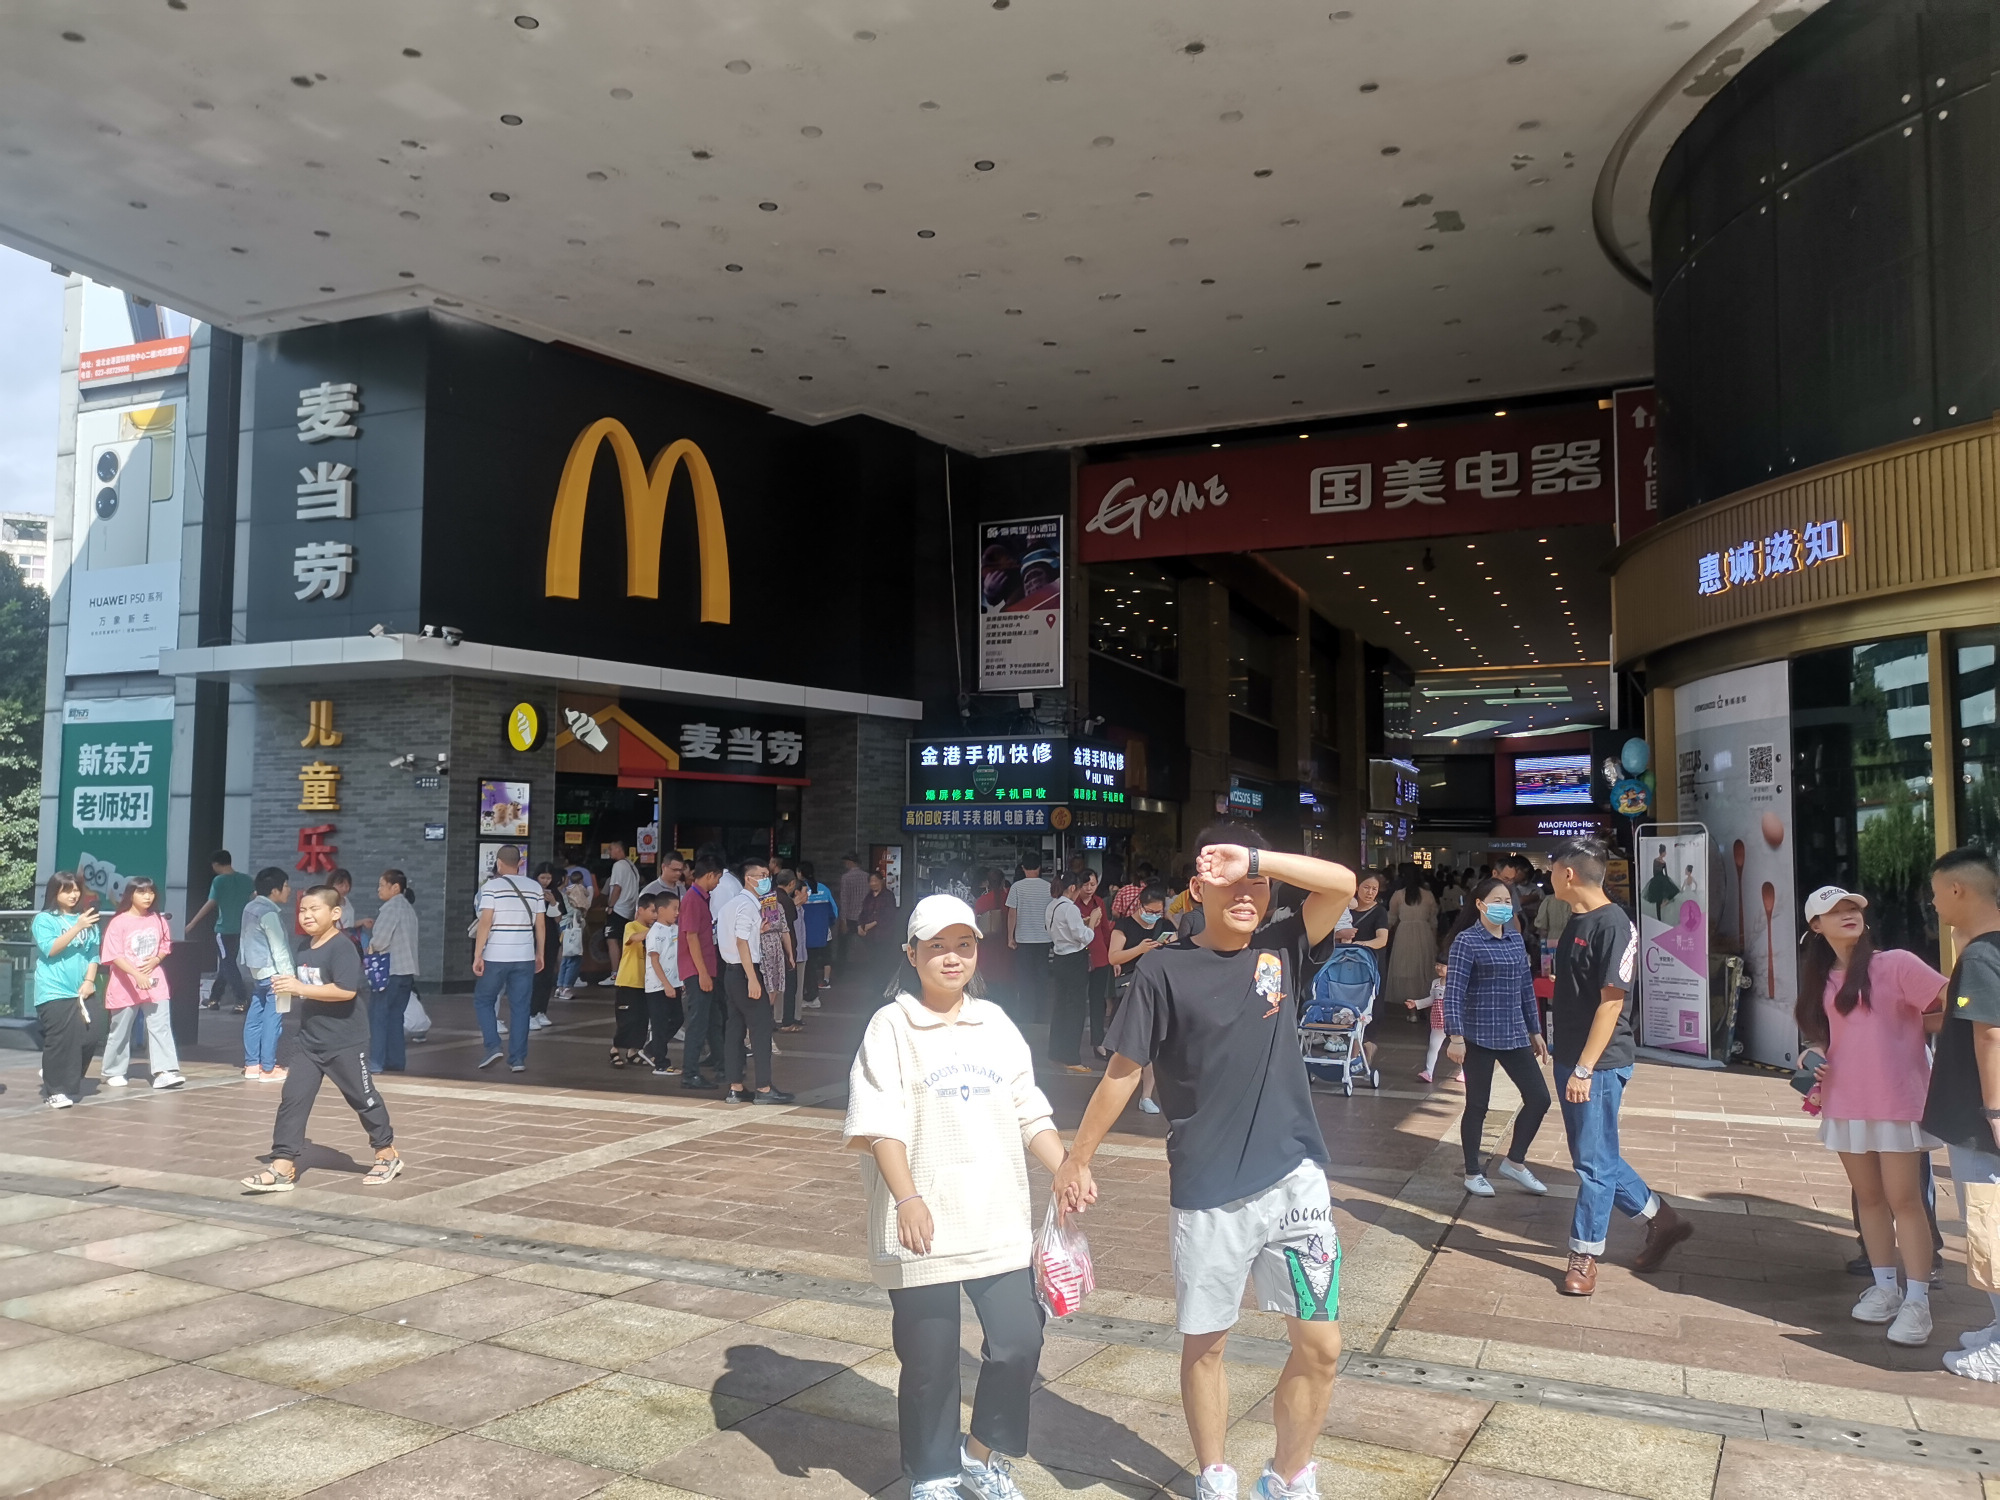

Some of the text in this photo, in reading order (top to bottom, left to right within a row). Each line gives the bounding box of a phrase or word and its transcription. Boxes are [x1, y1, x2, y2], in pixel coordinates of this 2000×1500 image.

[1310, 439, 1602, 514] 国美电器
[294, 381, 360, 601] 麦当劳
[1697, 519, 1845, 597] 惠诚滋知
[89, 594, 127, 608] HUAWEI
[130, 592, 145, 604] P50
[680, 722, 803, 766] 麦当劳
[920, 743, 1053, 766] 金港手机快修
[78, 741, 153, 776] 新东方
[1073, 746, 1125, 771] 金港手机快修
[77, 792, 149, 822] 老师好!
[925, 787, 1047, 801] 爆屏修复 手机回收
[983, 810, 1002, 825] 相机
[1004, 810, 1023, 825] 电脑
[1025, 809, 1045, 825] 黄金
[923, 1063, 1003, 1088] LOUIS HEART
